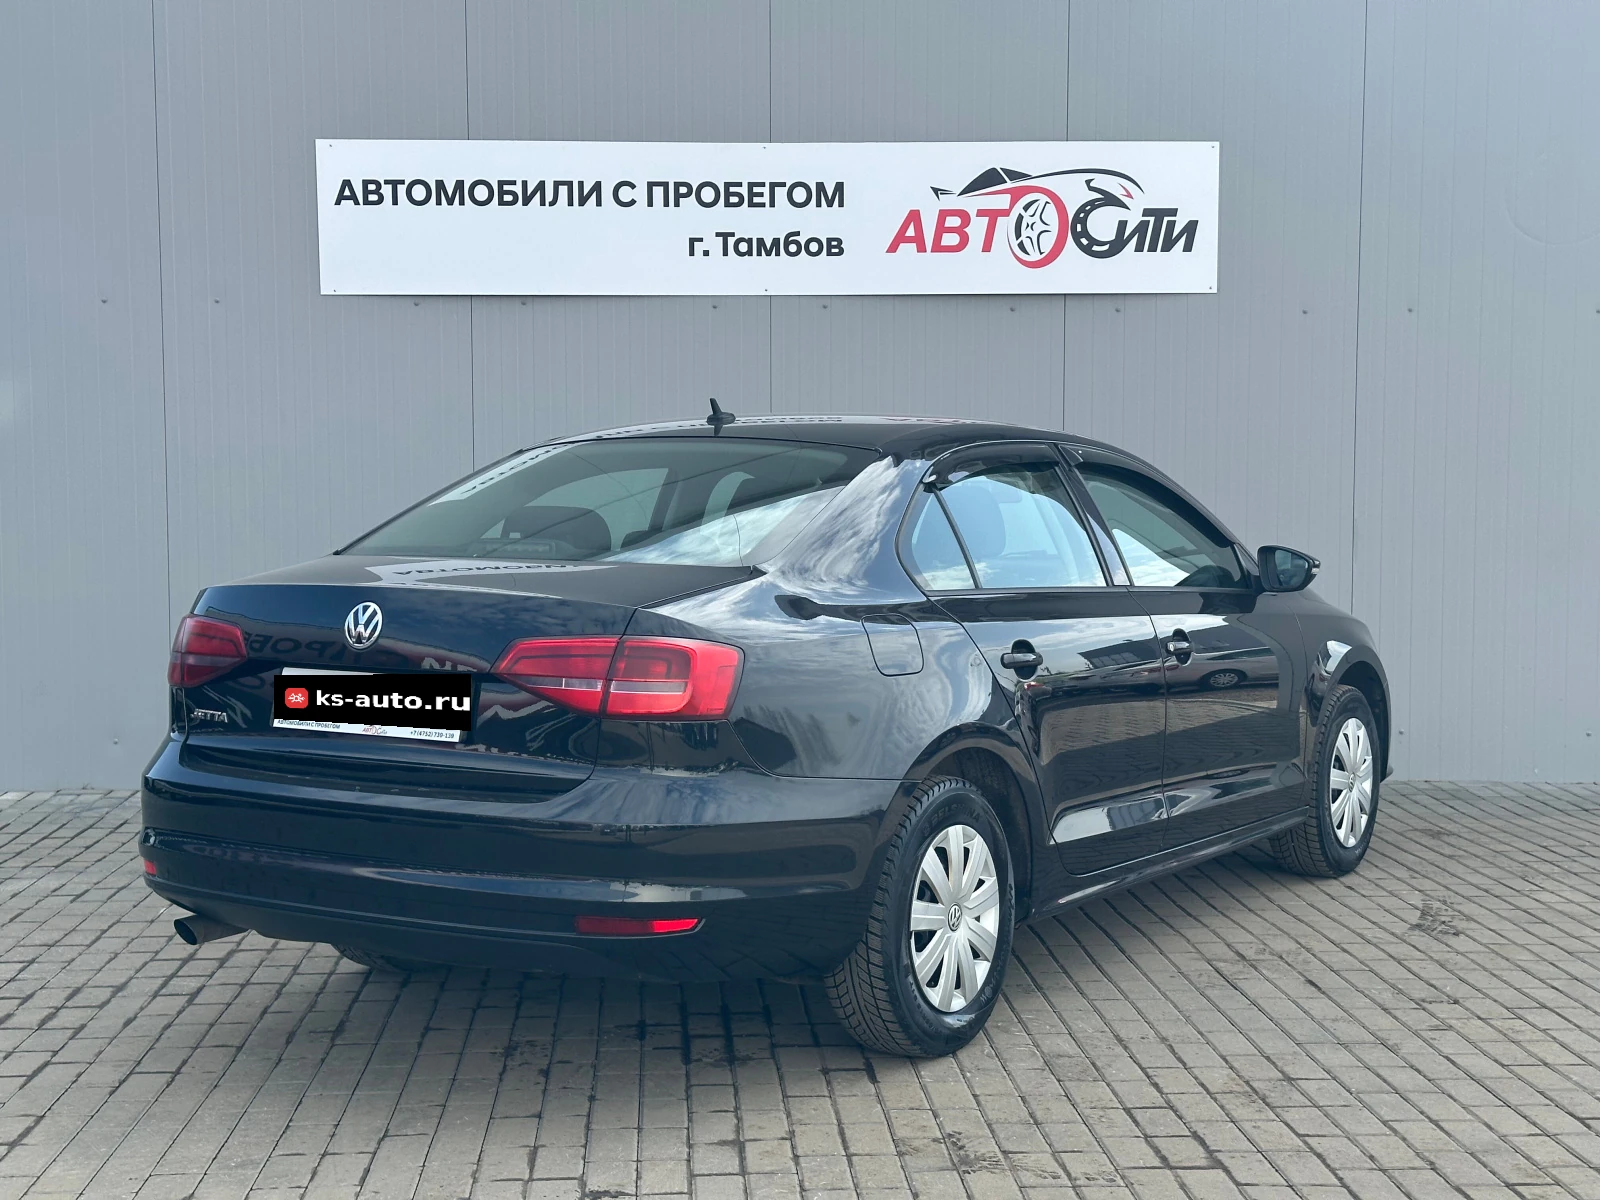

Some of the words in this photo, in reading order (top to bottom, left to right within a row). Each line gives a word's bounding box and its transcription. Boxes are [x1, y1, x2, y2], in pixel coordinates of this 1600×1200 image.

[334, 178, 602, 208] АВТОМОБИЛИ
[612, 180, 637, 208] С
[646, 180, 845, 209] ПРОБЕГОМ
[688, 237, 709, 257] г.
[714, 230, 845, 257] Тамбов
[190, 708, 228, 723] JETTA
